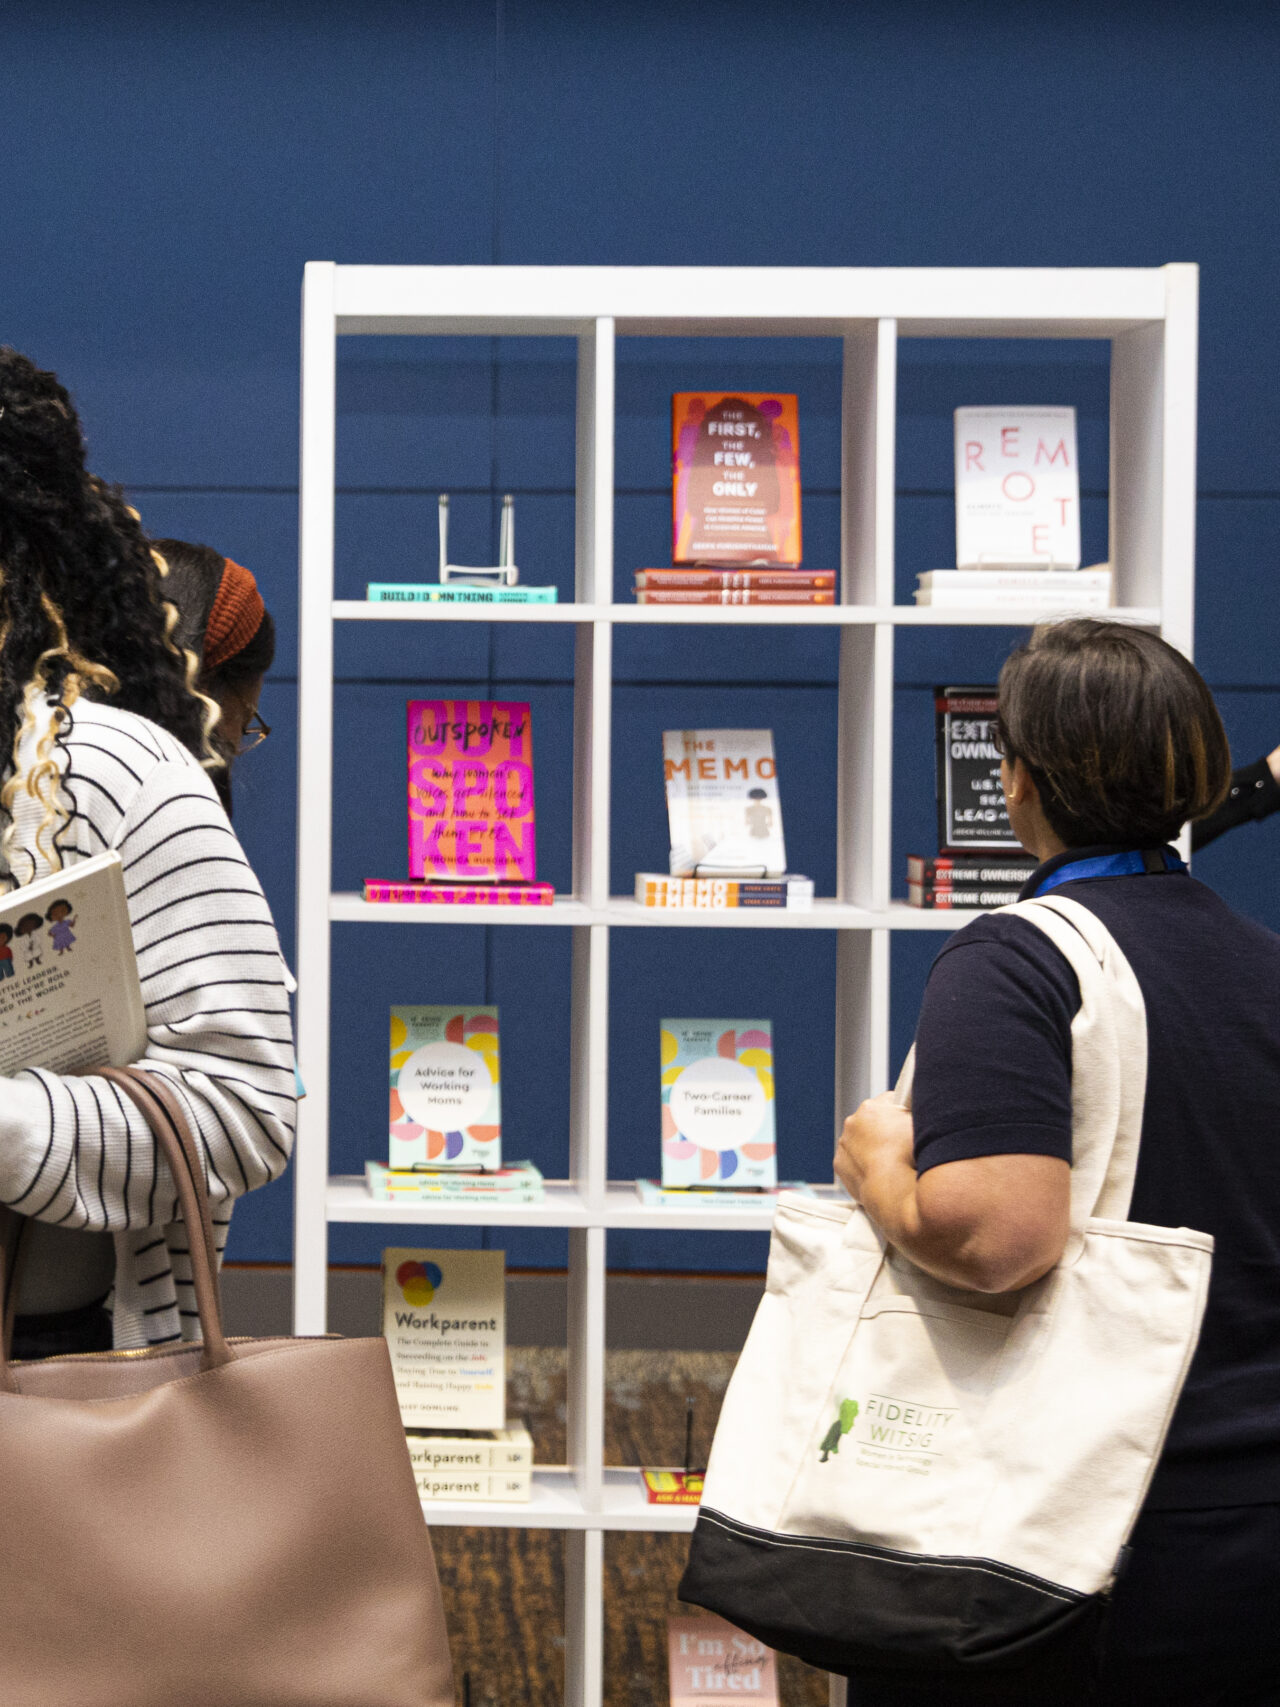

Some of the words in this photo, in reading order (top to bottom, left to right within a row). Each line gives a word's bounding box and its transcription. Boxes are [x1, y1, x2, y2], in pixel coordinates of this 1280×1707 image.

[708, 422, 761, 438] FIRST,
[723, 442, 743, 450] THE
[714, 452, 755, 468] FEW,
[722, 472, 744, 480] THE
[713, 482, 758, 497] ONLY
[380, 591, 415, 601] BUILD
[457, 592, 493, 602] THING
[951, 720, 999, 740] EXT
[683, 739, 715, 752] THE
[664, 757, 778, 782] MEMO
[979, 794, 1007, 806] SEA
[954, 808, 998, 822] LEAD
[935, 869, 979, 881] EXTREME
[935, 892, 979, 905] EXTREME
[415, 1066, 455, 1077] Advice
[458, 1066, 475, 1077] for
[420, 1080, 470, 1092] Working
[427, 1096, 463, 1105] Moms
[683, 1090, 753, 1102] Two-Career
[693, 1104, 743, 1116] Families
[395, 1311, 497, 1336] Workparent
[864, 1399, 955, 1428] FIDELITY
[410, 1448, 481, 1469] orkparent
[415, 1475, 480, 1497] rkparent
[680, 1633, 723, 1656] I'm
[732, 1635, 765, 1656] So
[685, 1666, 761, 1690] Tired
